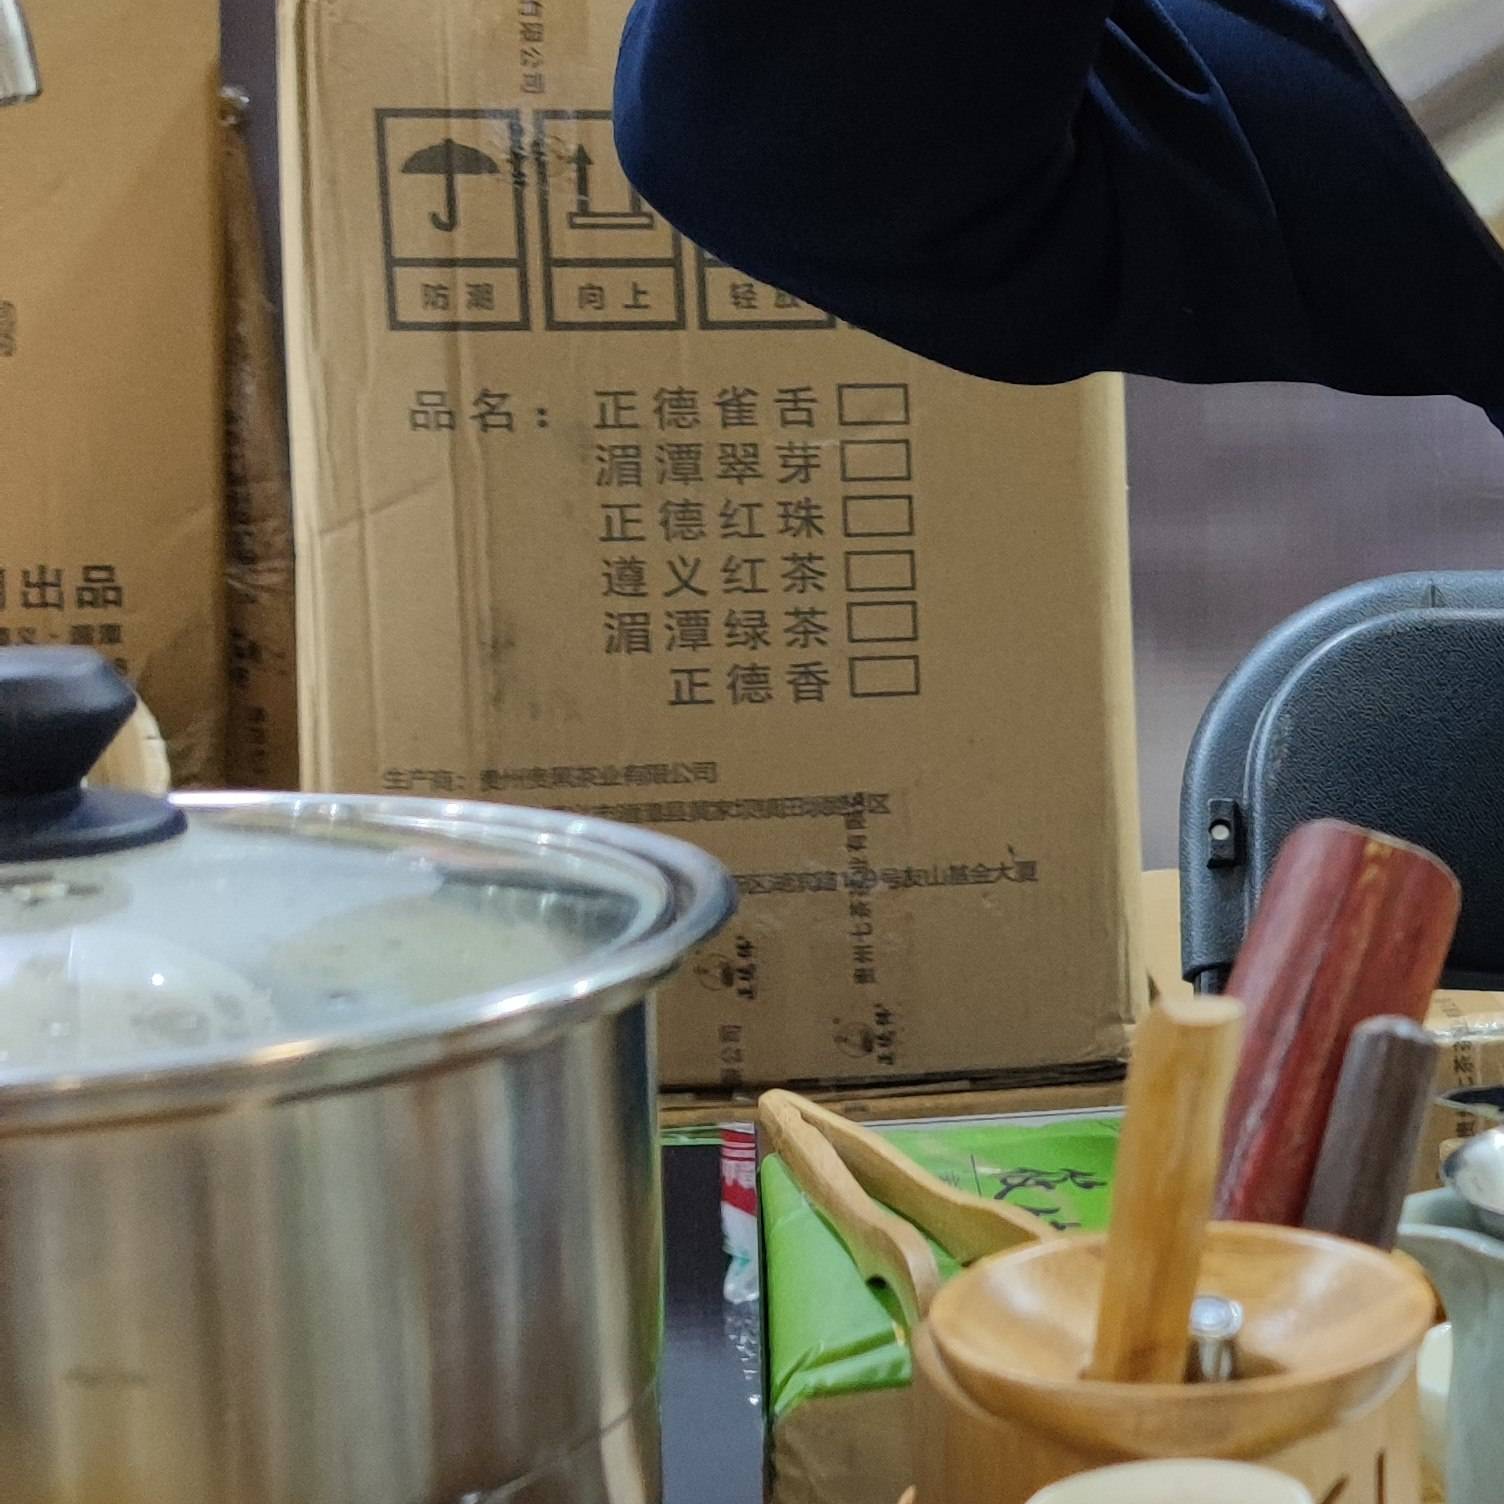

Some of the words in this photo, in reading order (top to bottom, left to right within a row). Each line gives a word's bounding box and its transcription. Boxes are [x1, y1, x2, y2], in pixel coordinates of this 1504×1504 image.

[421, 281, 496, 312] 防潮
[577, 280, 651, 312] 向上
[594, 385, 821, 432] 正德雀舌
[595, 441, 823, 489] 湄潭翠芽
[600, 497, 826, 543] 正德红珠
[601, 553, 829, 600] 遵义红茶
[603, 607, 830, 656] 湄潭绿茶
[668, 662, 830, 708] 正德香
